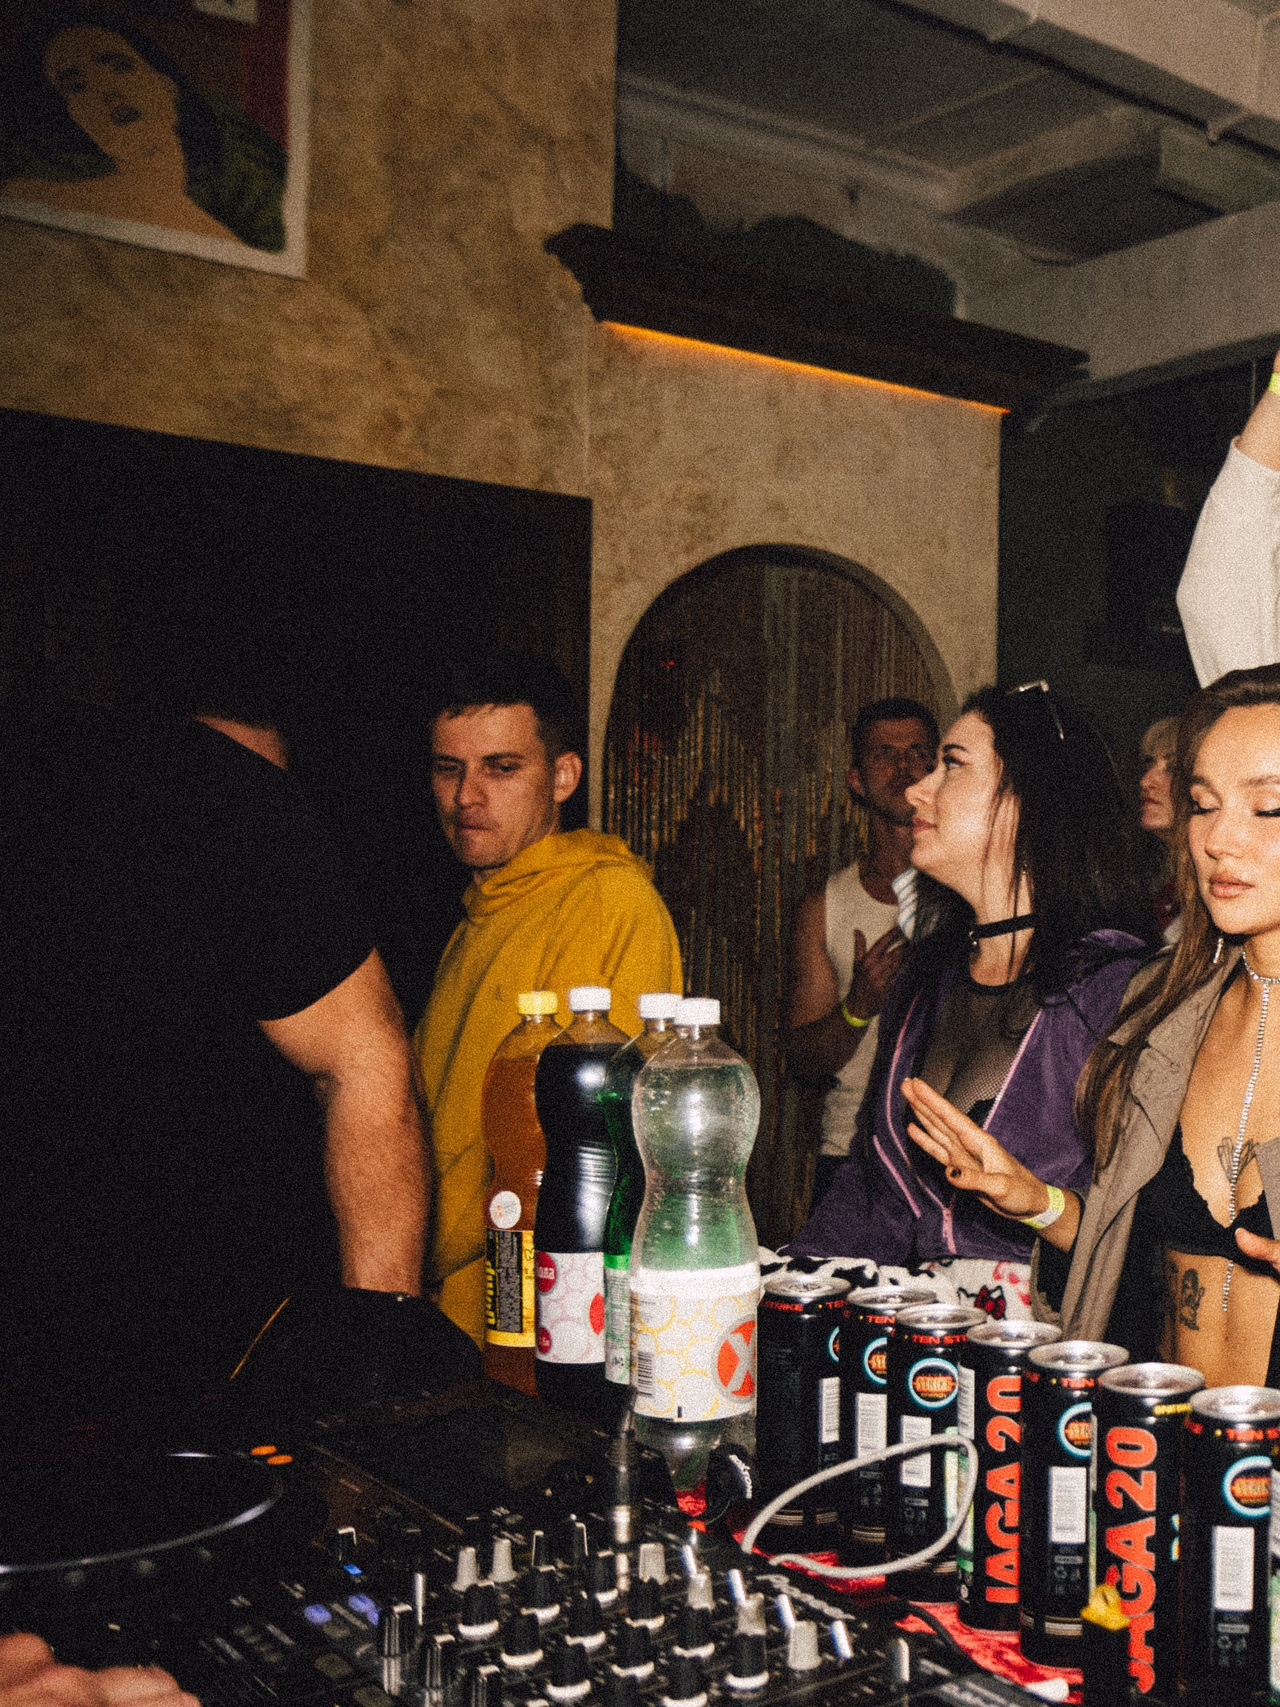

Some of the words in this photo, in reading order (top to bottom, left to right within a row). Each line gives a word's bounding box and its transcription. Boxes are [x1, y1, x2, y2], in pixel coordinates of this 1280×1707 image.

[867, 1315, 895, 1324] TEN
[912, 1334, 940, 1345] TEN
[1105, 1426, 1158, 1511] 20
